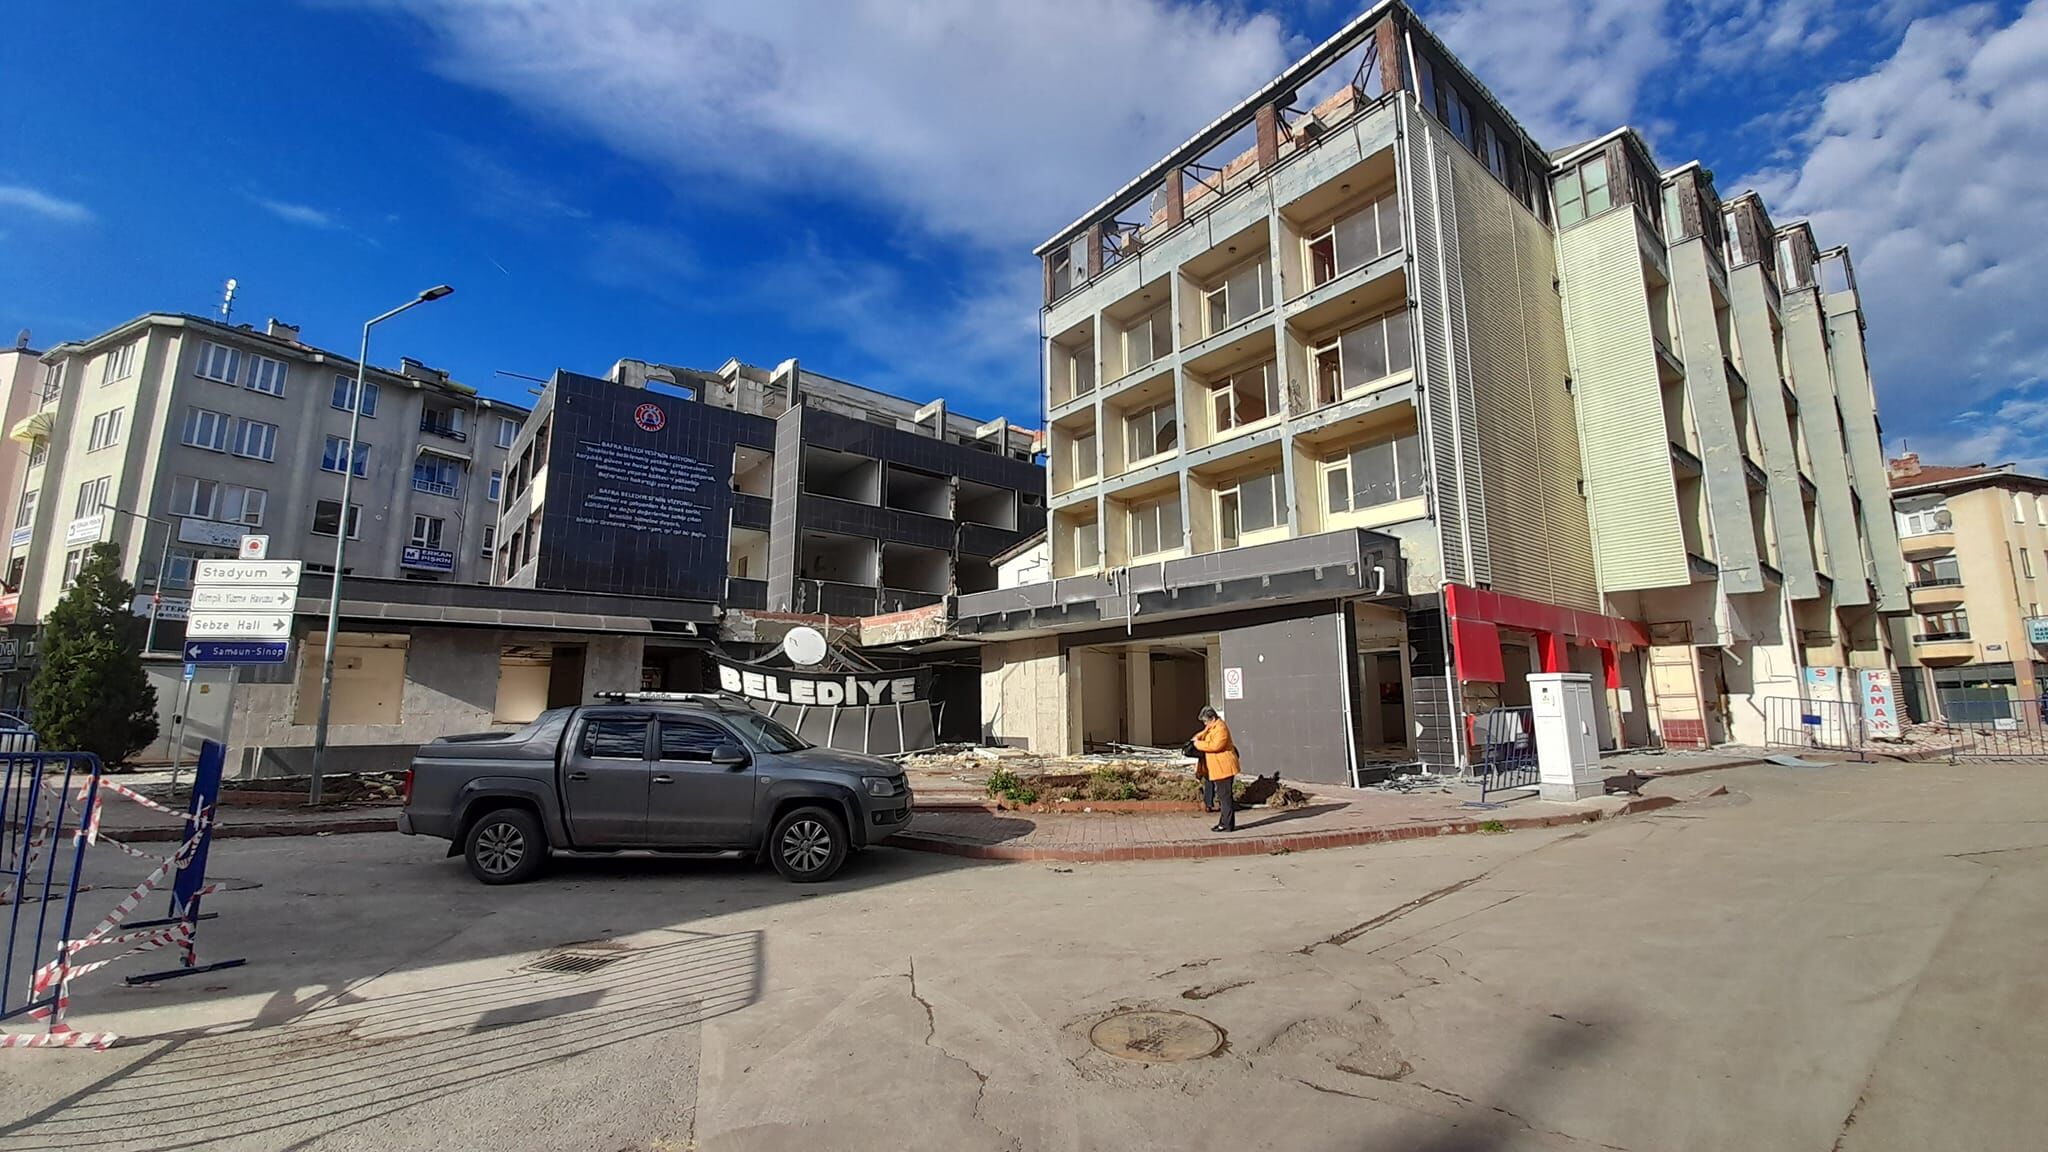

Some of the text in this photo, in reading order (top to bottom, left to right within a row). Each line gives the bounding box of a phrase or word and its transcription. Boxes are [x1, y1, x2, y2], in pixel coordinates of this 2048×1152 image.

[601, 441, 622, 450] BAFRA
[598, 488, 620, 496] BAFRA
[203, 567, 268, 580] Stadyum
[194, 619, 230, 630] Sebze
[212, 647, 284, 658] Samsun-Sinop
[718, 663, 916, 706] BELEDİYE
